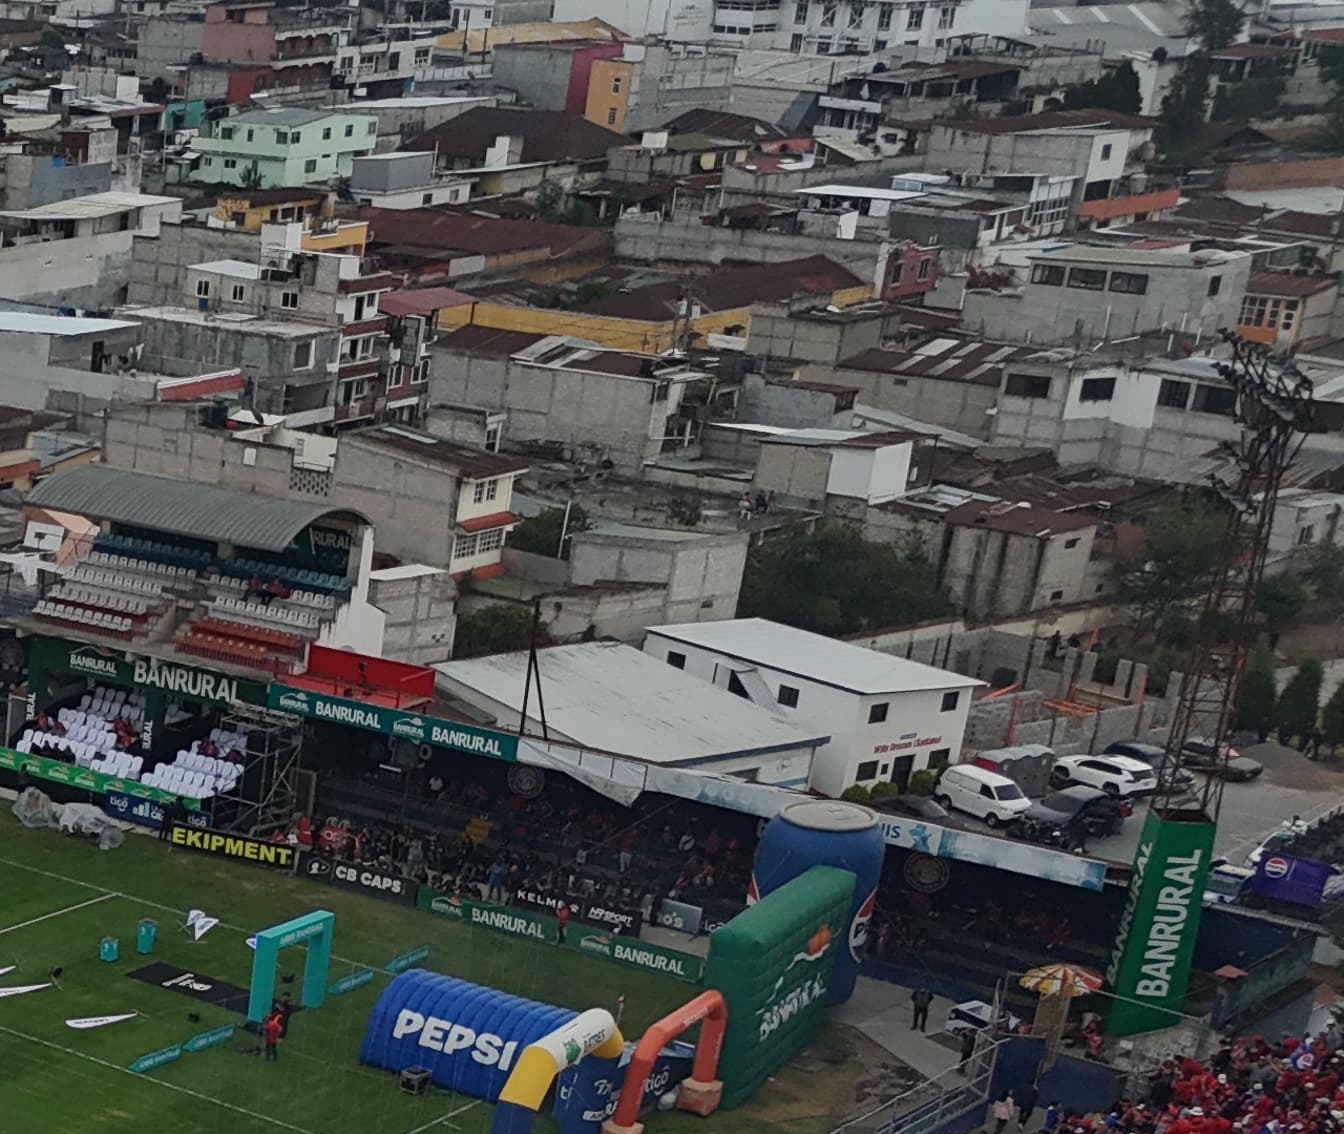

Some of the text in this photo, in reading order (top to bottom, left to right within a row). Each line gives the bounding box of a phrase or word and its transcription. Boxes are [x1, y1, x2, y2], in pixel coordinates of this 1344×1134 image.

[312, 530, 352, 549] RURAL
[70, 652, 118, 674] BANRURAL
[133, 660, 241, 703] BANRURAL
[315, 701, 381, 730] BANRURAL
[431, 726, 502, 756] BANRURAL
[171, 826, 292, 865] EKIPMENT
[335, 864, 402, 894] CB CAPS
[471, 907, 545, 940] BANRURAL
[1107, 842, 1152, 985] BANRURAL
[1136, 849, 1203, 999] BANRURAL
[614, 944, 685, 976] BANRURAL
[392, 1008, 519, 1072] PEPSI
